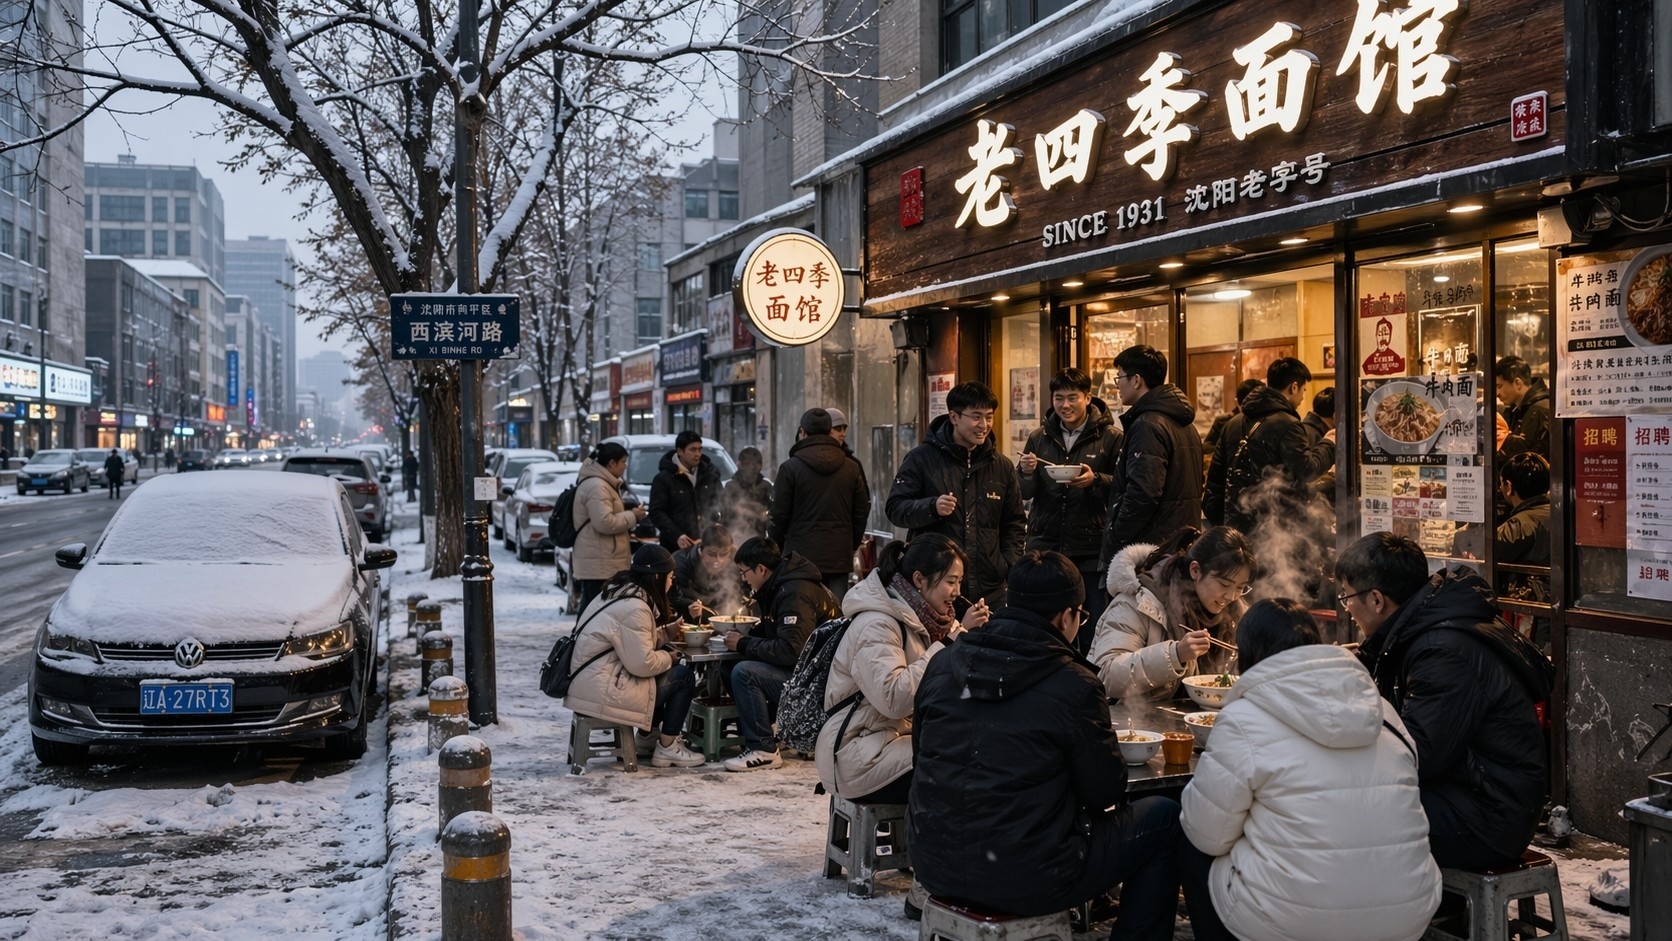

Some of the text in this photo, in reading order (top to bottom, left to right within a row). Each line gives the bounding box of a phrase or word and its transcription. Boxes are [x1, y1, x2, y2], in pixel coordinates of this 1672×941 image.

[955, 0, 1461, 229] 老四季面馆
[1184, 152, 1331, 213] 沈阳老字号
[1042, 196, 1167, 248] SINCE 1931
[756, 260, 830, 289] 老四季
[766, 295, 822, 323] 面馆
[410, 321, 502, 342] 西滨河路
[429, 346, 483, 354] XI BINHE RO
[1584, 427, 1618, 446] 招聘
[1635, 426, 1671, 446] 招聘
